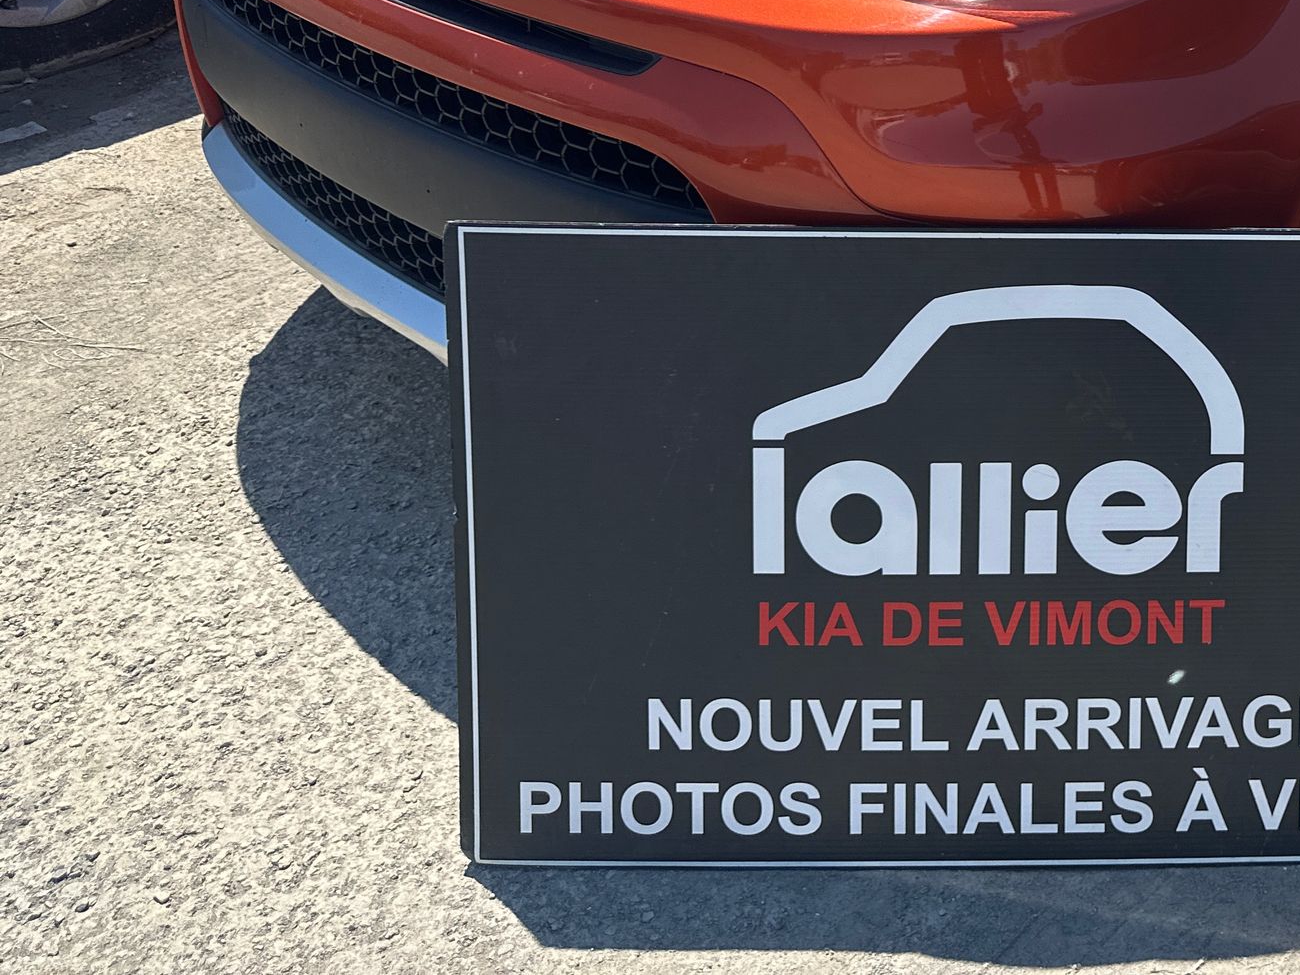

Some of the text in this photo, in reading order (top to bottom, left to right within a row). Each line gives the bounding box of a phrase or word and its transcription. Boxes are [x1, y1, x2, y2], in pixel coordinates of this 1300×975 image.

[752, 439, 1245, 577] lallier
[759, 599, 1226, 646] KIA DE VIMONT
[647, 697, 951, 752] NOUVEL
[519, 781, 823, 836] PHOTOS
[849, 780, 1154, 836] FINALES
[1175, 767, 1229, 833] À
